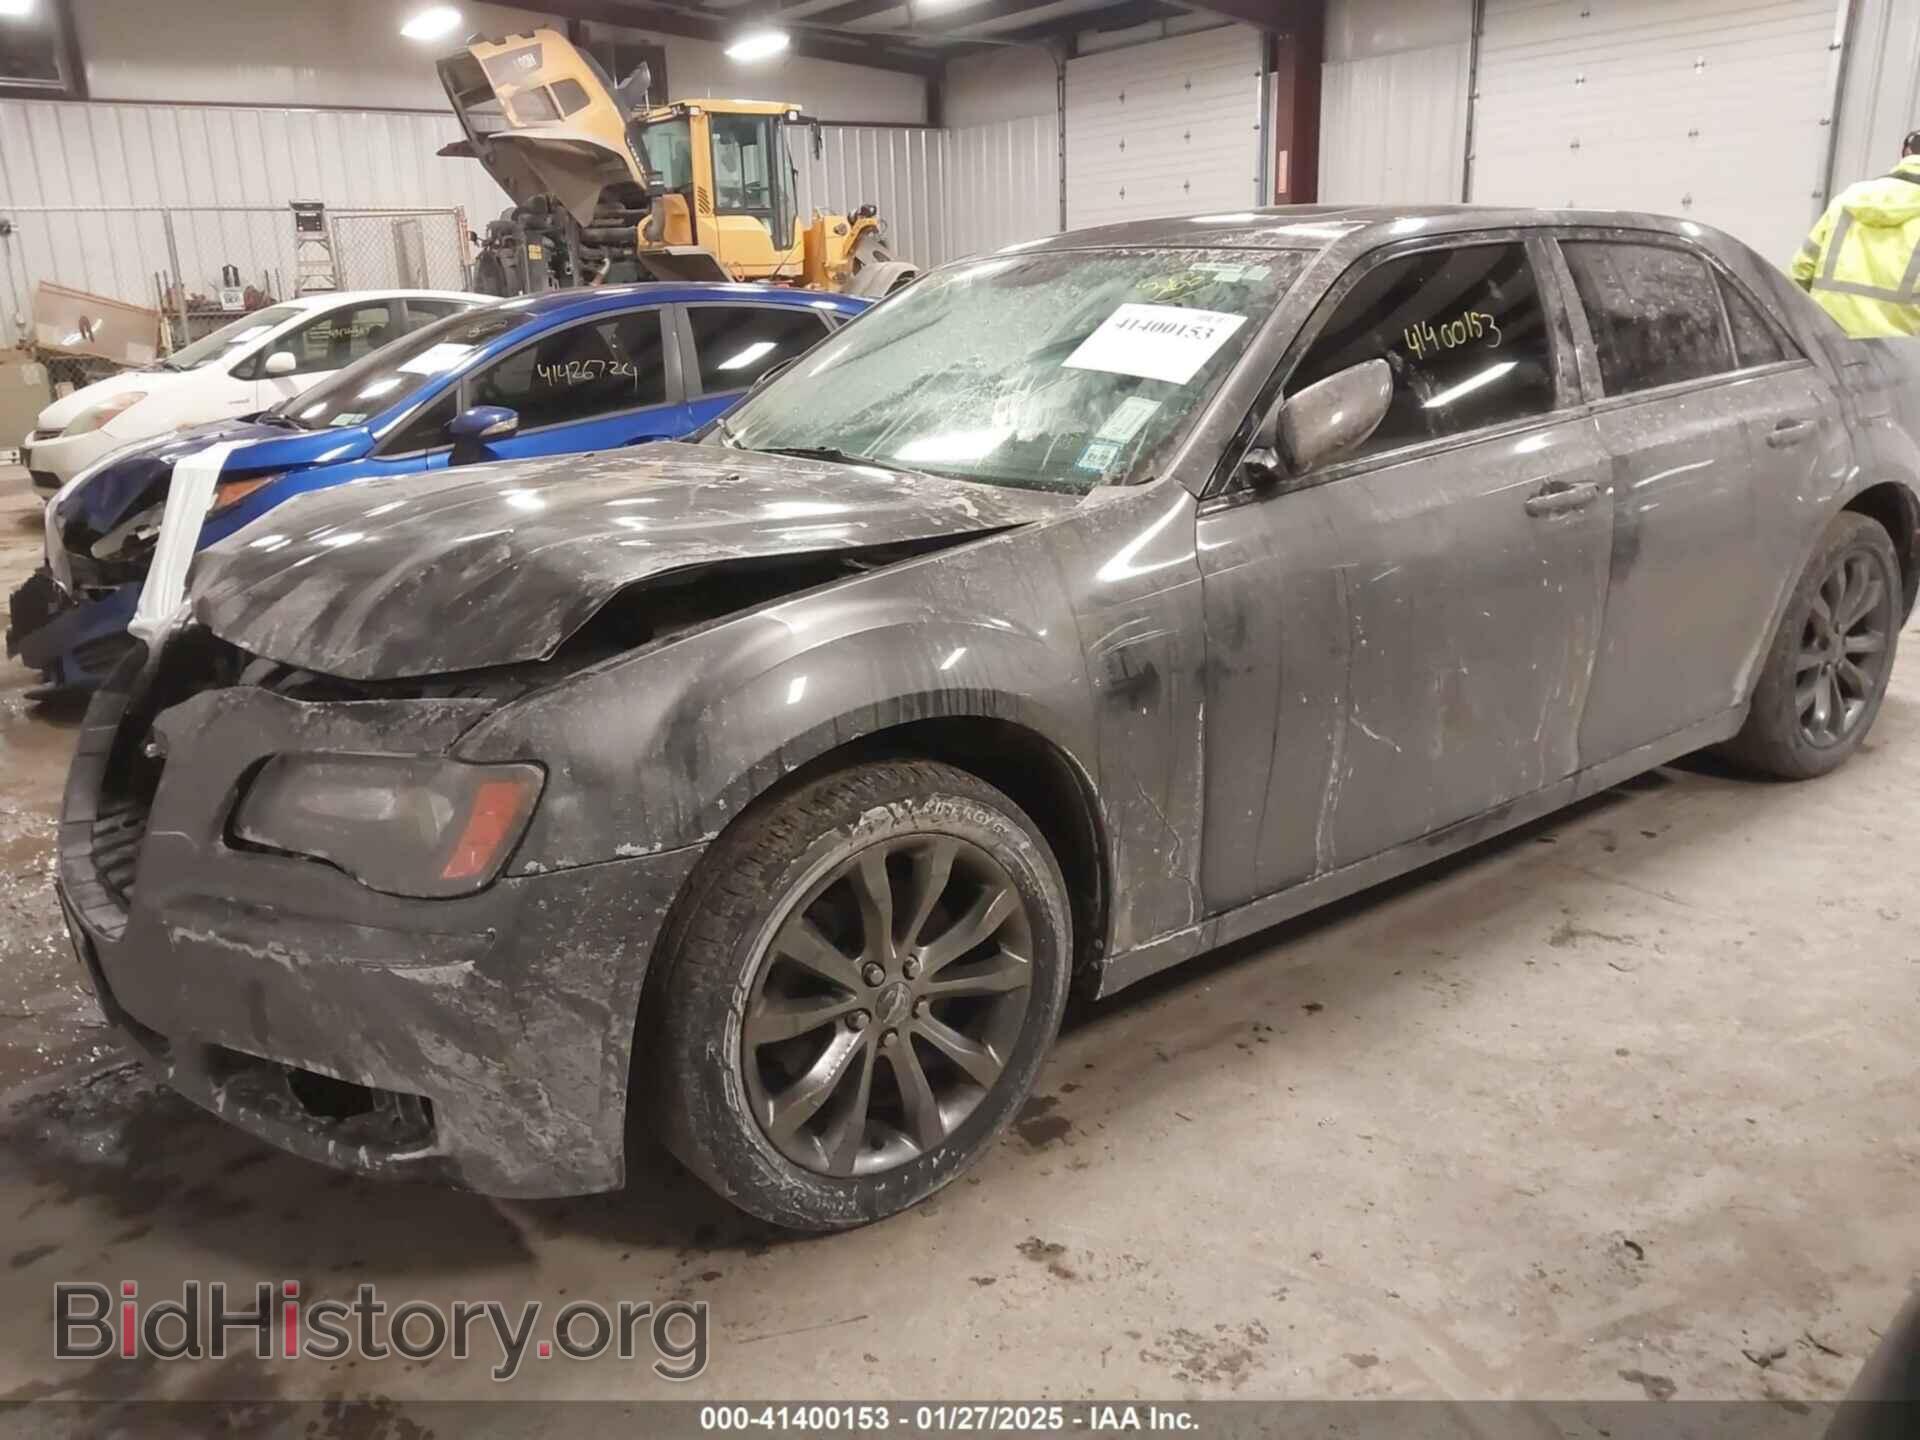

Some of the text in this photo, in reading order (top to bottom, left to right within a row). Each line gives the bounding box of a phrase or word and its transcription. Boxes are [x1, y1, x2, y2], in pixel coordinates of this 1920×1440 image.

[1115, 318, 1215, 341] 41400153
[1404, 312, 1502, 360] 41400153
[537, 359, 639, 392] 41426724
